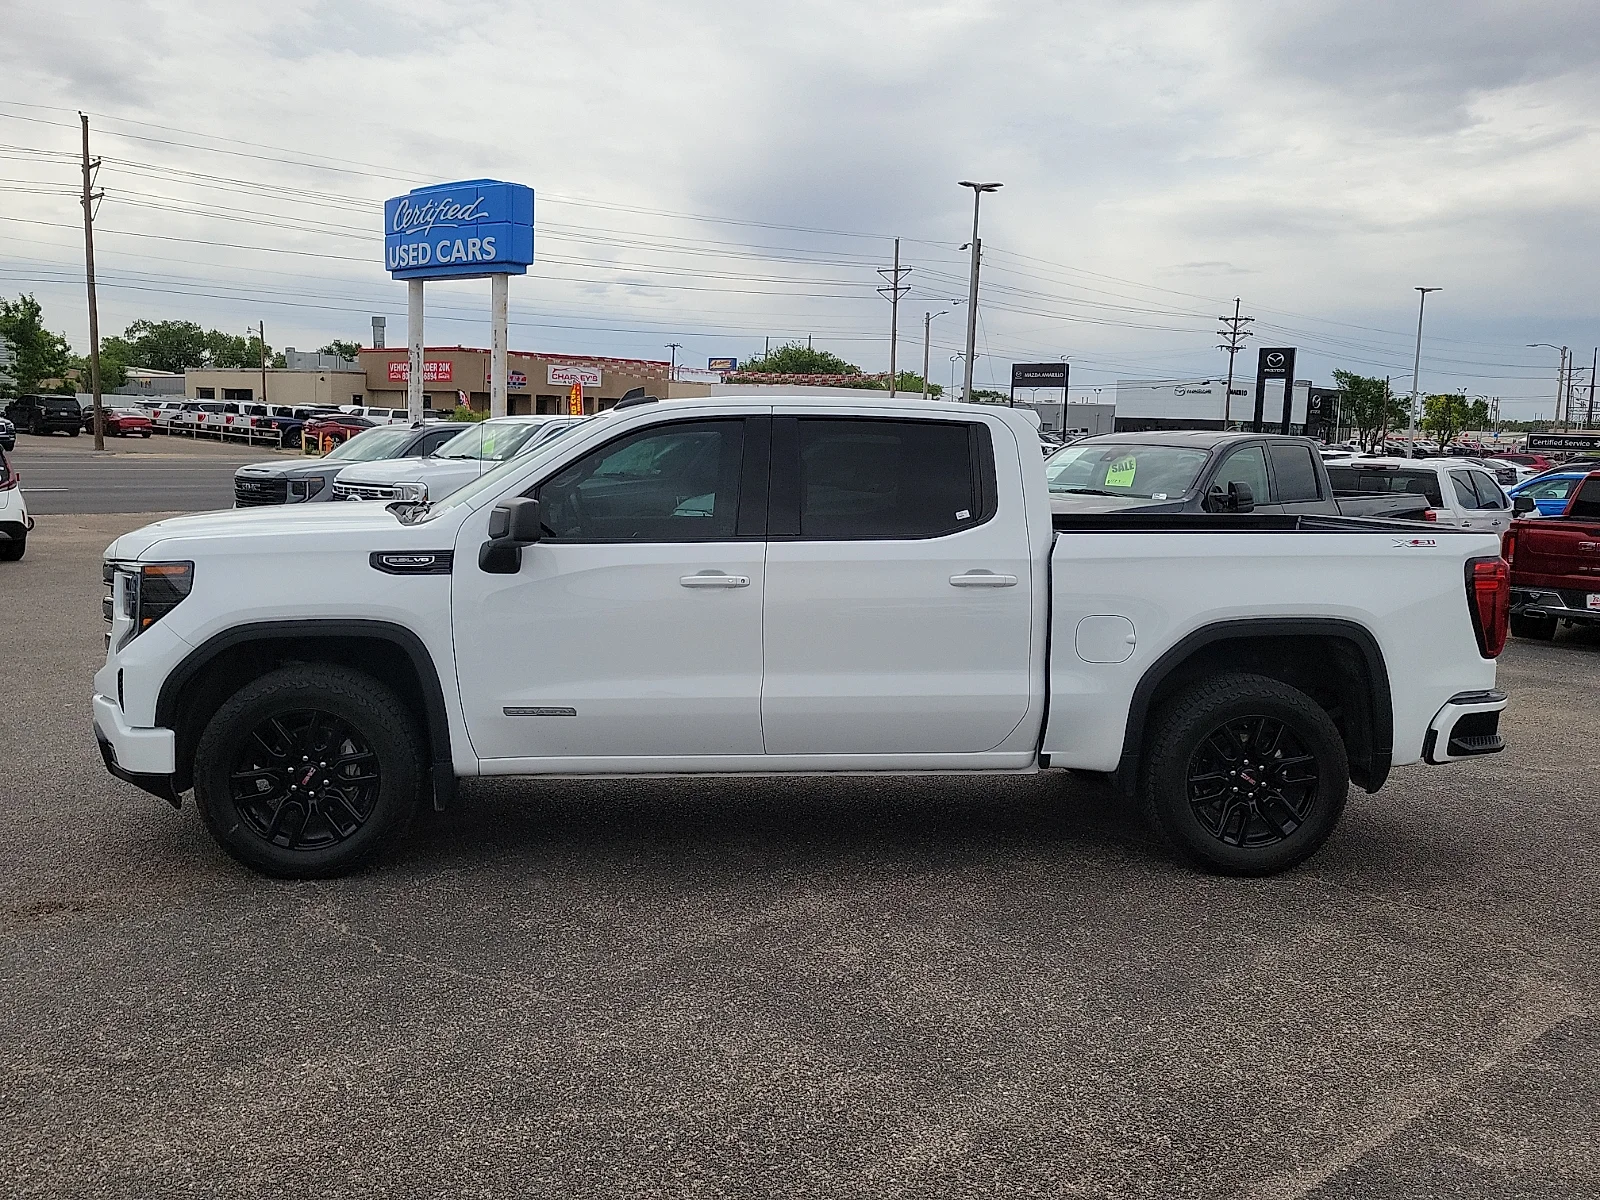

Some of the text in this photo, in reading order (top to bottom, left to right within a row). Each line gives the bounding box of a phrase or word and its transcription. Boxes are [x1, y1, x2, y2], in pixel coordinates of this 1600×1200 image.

[393, 196, 489, 237] Certified
[389, 236, 496, 268] USED CARS
[389, 363, 410, 372] VEHIC
[1532, 438, 1563, 446] Certified
[1111, 459, 1135, 473] SALE
